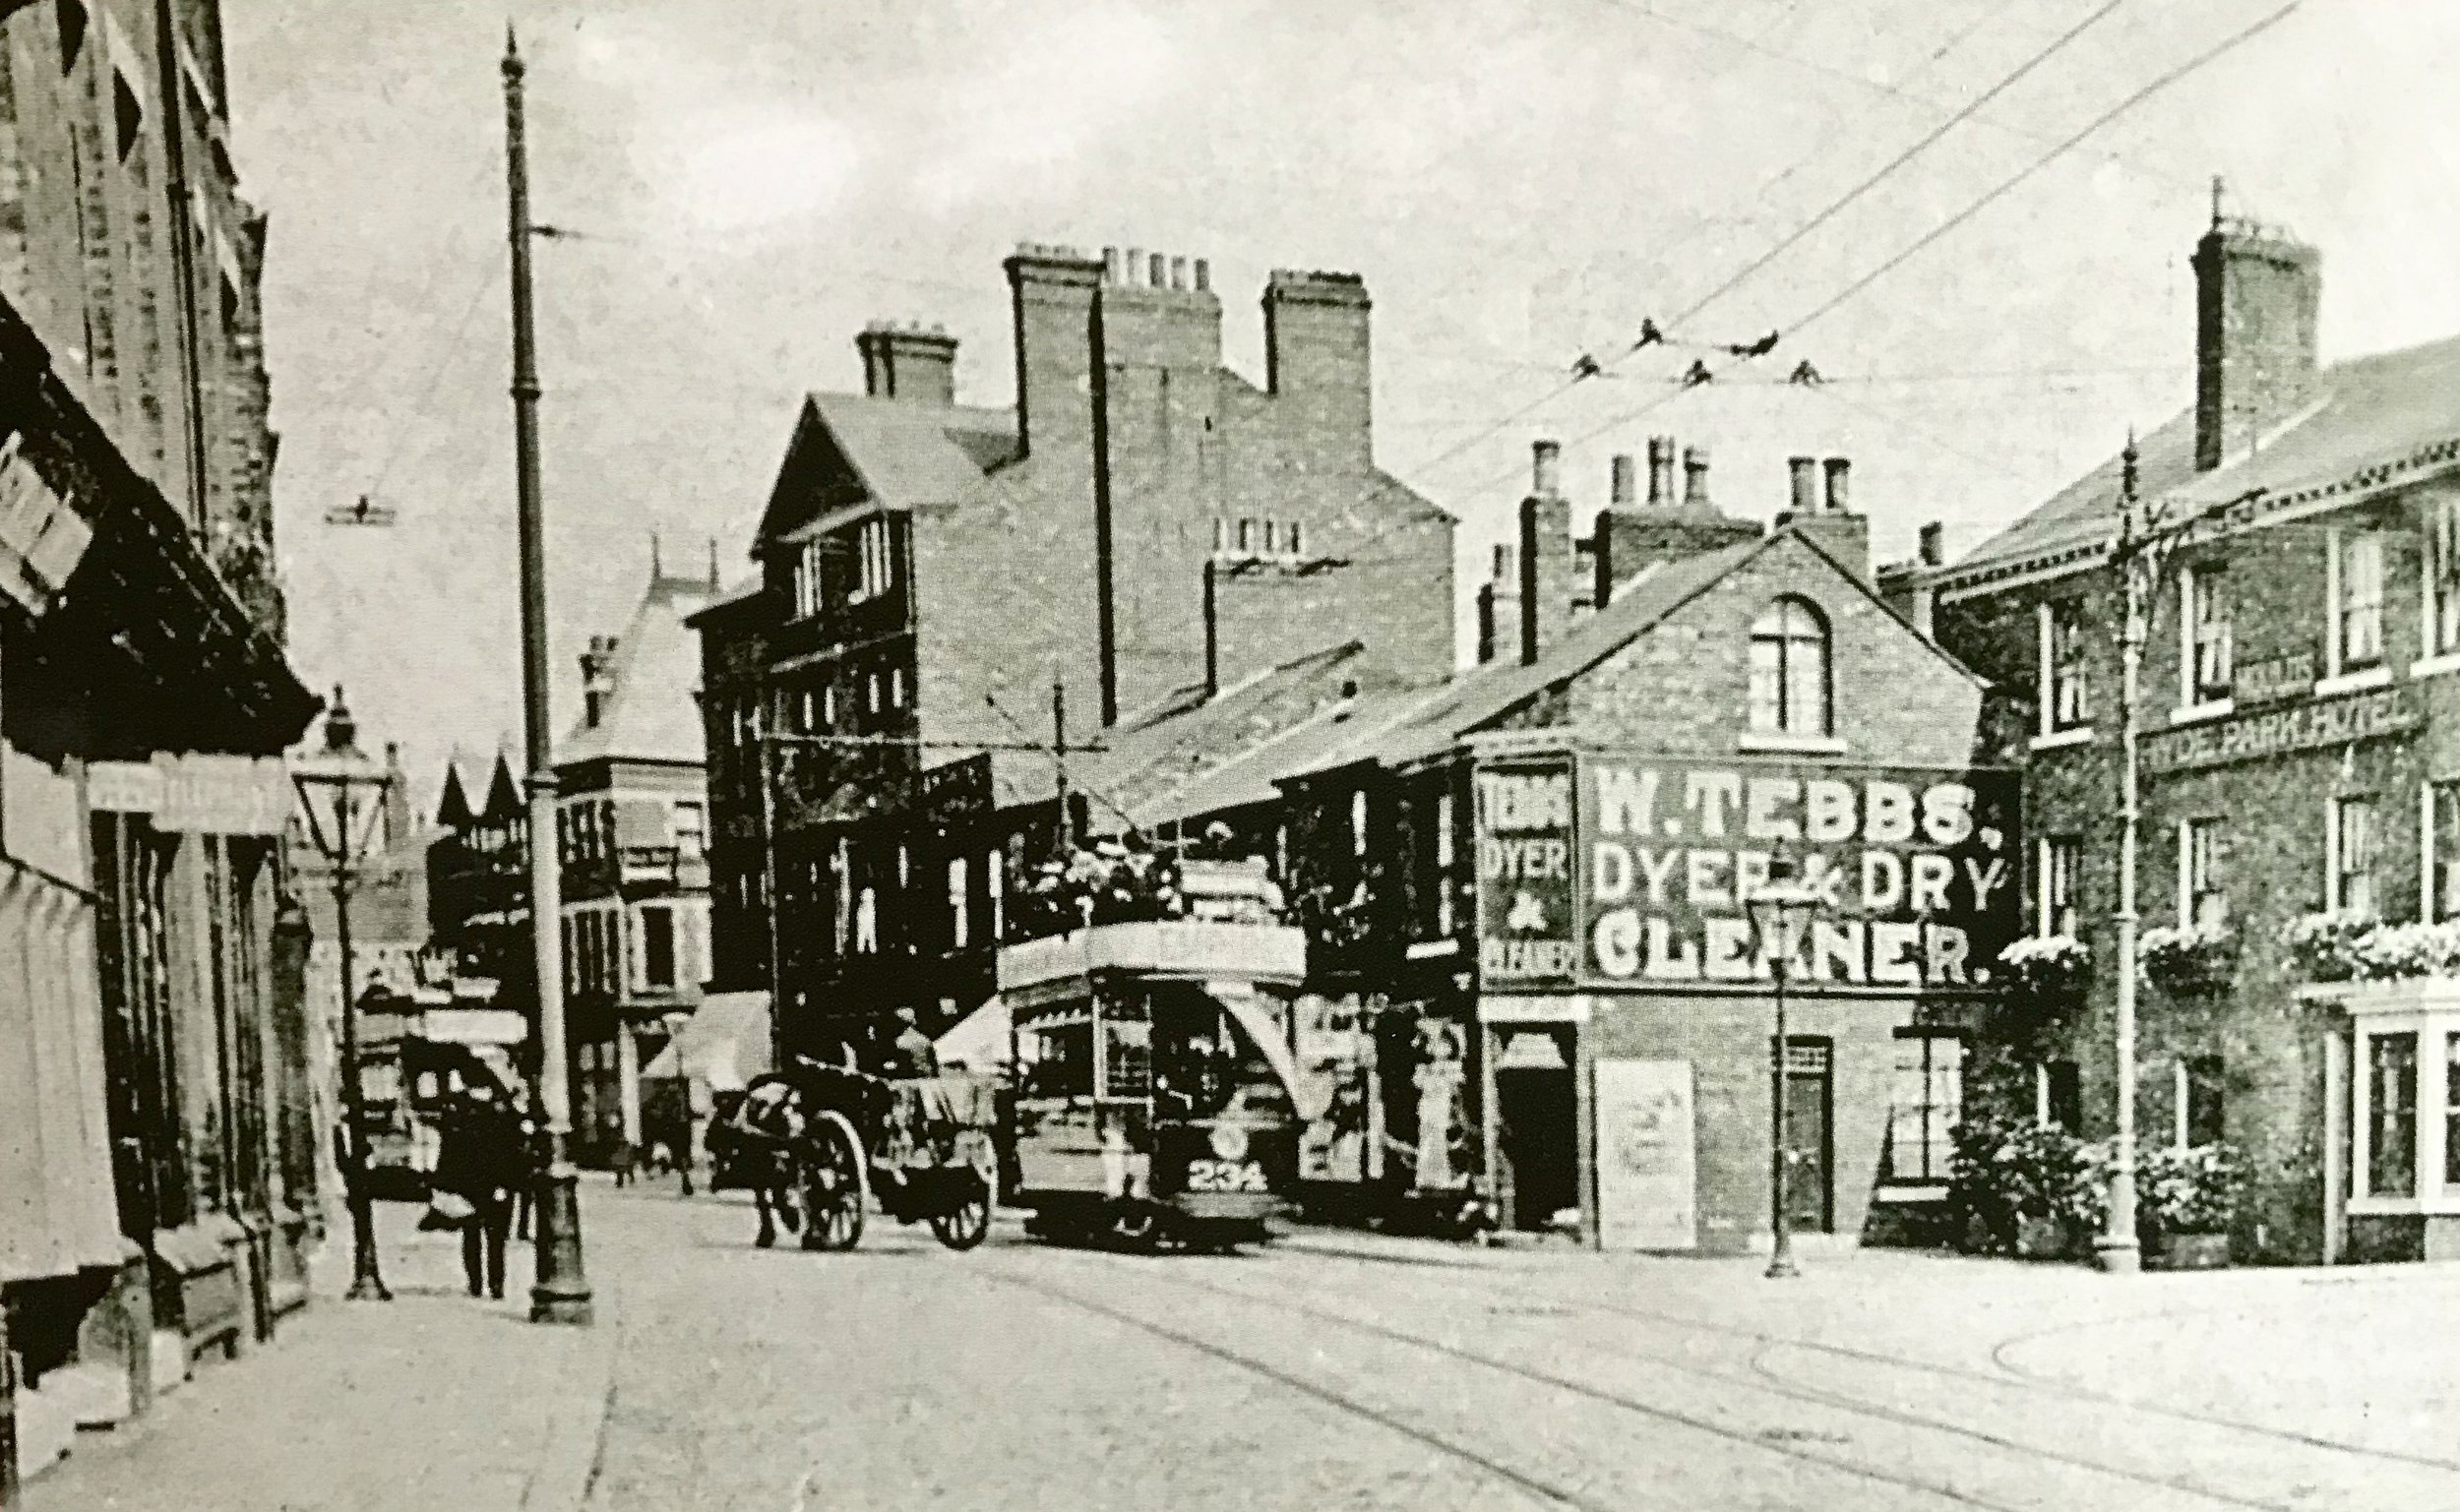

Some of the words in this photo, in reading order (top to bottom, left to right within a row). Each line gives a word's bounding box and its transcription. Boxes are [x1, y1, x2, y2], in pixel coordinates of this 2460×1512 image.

[1480, 838, 1568, 879] DYER
[1593, 842, 1773, 903] DYER
[1799, 853, 1840, 907] &
[1863, 851, 2005, 912] DRY
